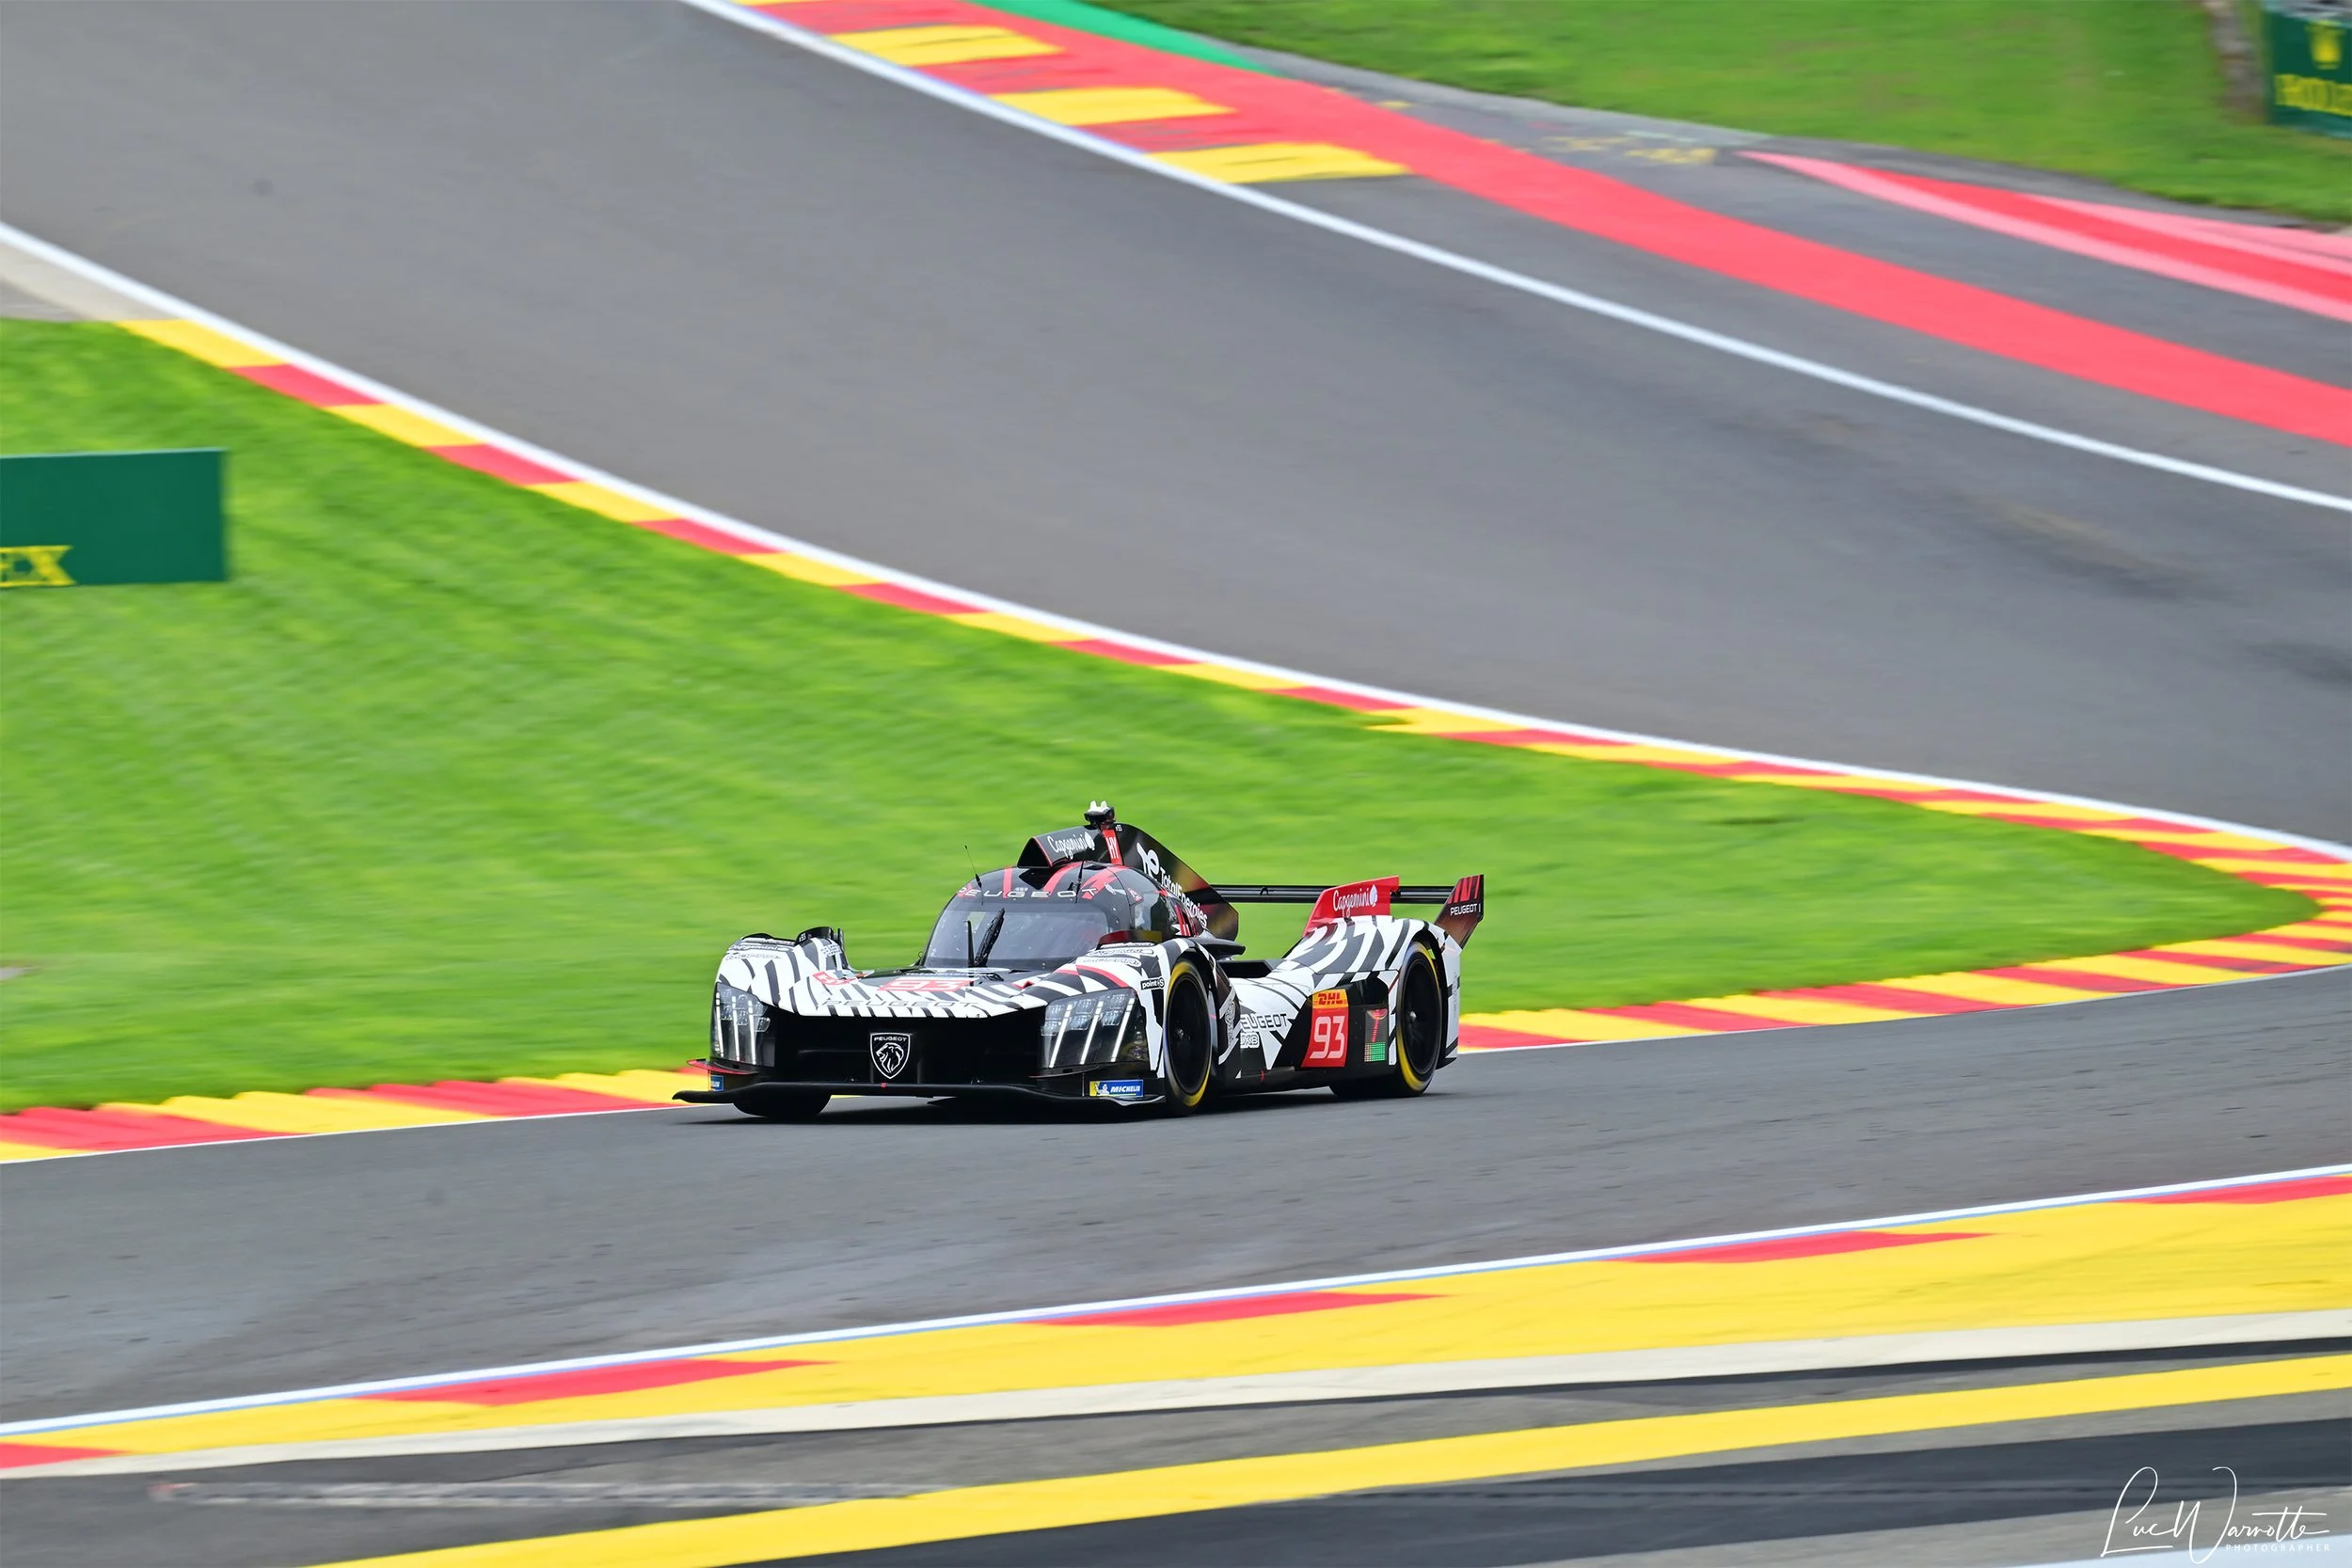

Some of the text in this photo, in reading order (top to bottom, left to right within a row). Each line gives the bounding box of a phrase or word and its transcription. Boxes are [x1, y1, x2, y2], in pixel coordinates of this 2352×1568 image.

[1047, 830, 1088, 860] Capgemini
[958, 887, 1098, 897] PEUGEOT
[1160, 866, 1208, 927] TotalEnergies
[1332, 888, 1370, 918] Capgemini
[1450, 905, 1477, 916] PEUGEOT
[886, 980, 958, 991] 93
[1318, 992, 1343, 1006] DHL
[1241, 1013, 1287, 1030] EUGEOT
[1309, 1015, 1345, 1059] 93
